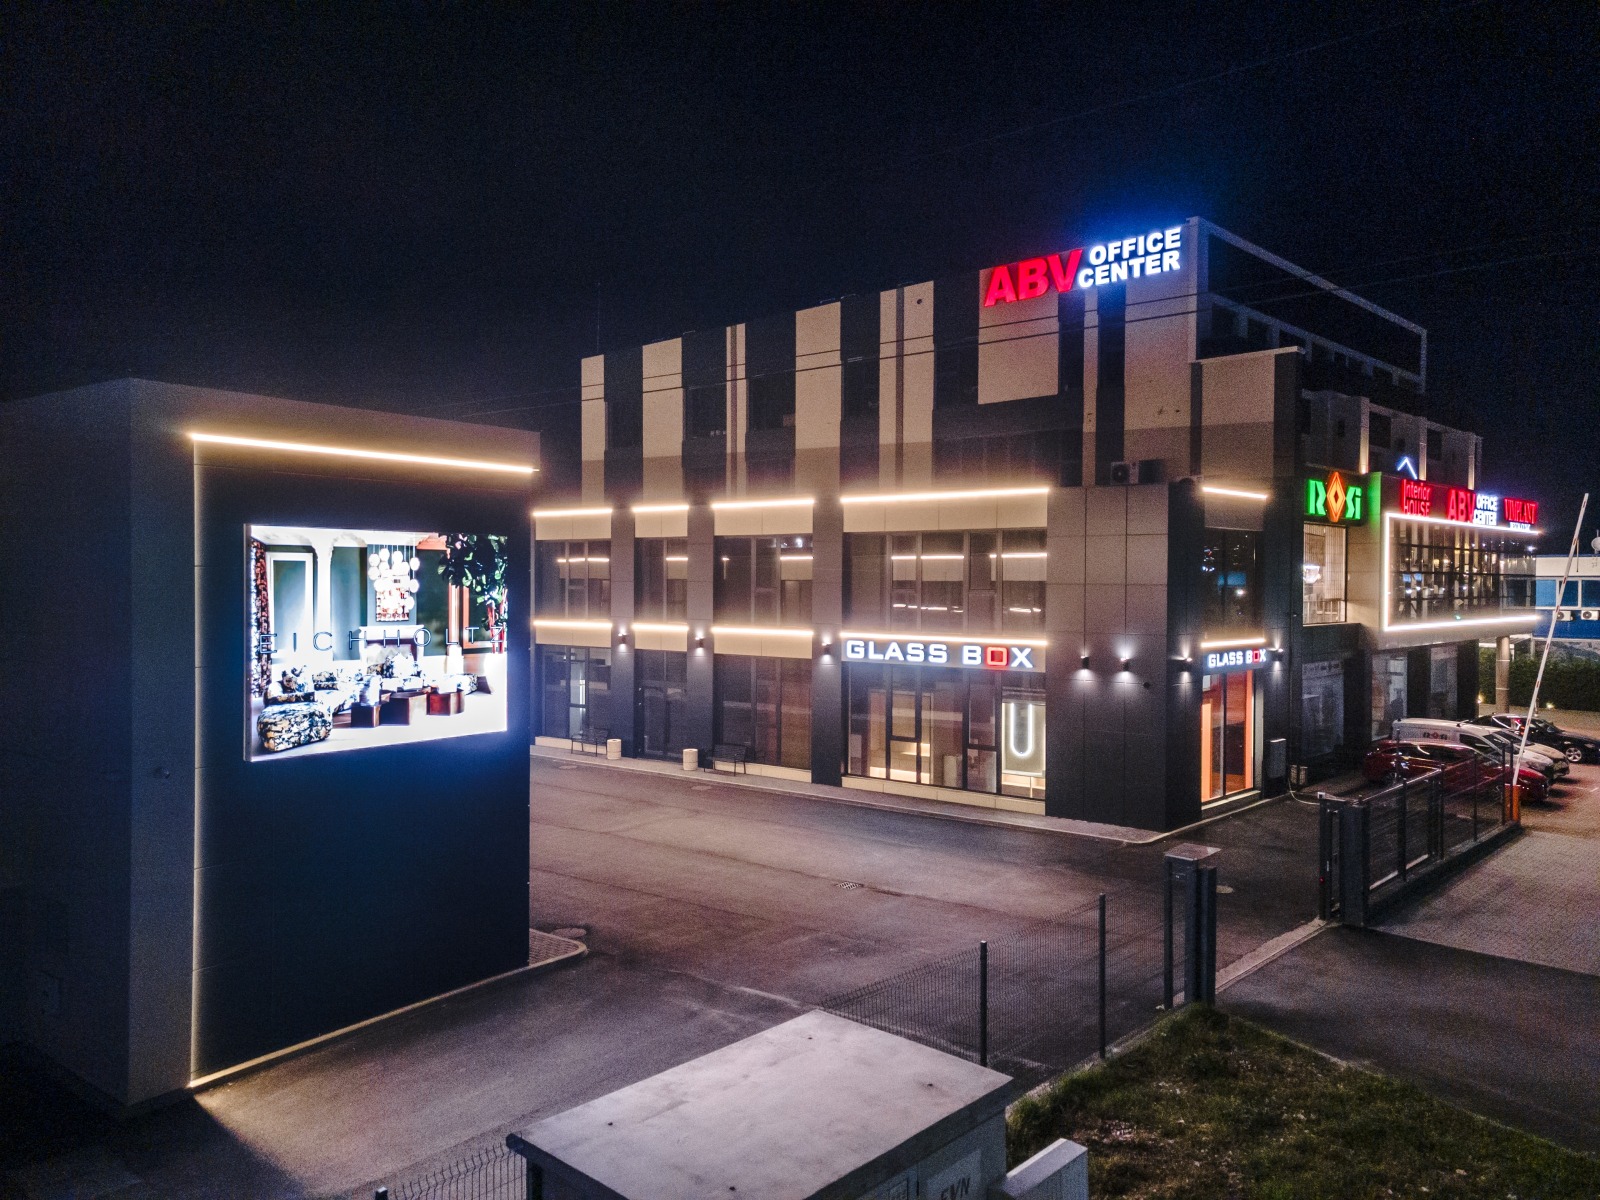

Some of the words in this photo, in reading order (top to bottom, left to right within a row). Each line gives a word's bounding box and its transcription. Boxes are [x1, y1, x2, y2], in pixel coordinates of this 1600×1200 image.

[1089, 226, 1182, 266] OFFICE
[984, 249, 1083, 307] ABV
[1078, 250, 1181, 288] CENTER
[1402, 498, 1431, 518] HOUSE
[1447, 488, 1476, 524] ABV
[1476, 493, 1498, 512] OFFICE
[259, 626, 505, 654] EICHHOLTZ
[846, 640, 948, 664] GLASS
[962, 645, 1034, 668] BOX
[1207, 650, 1244, 669] GLASS
[1245, 648, 1267, 665] BOX
